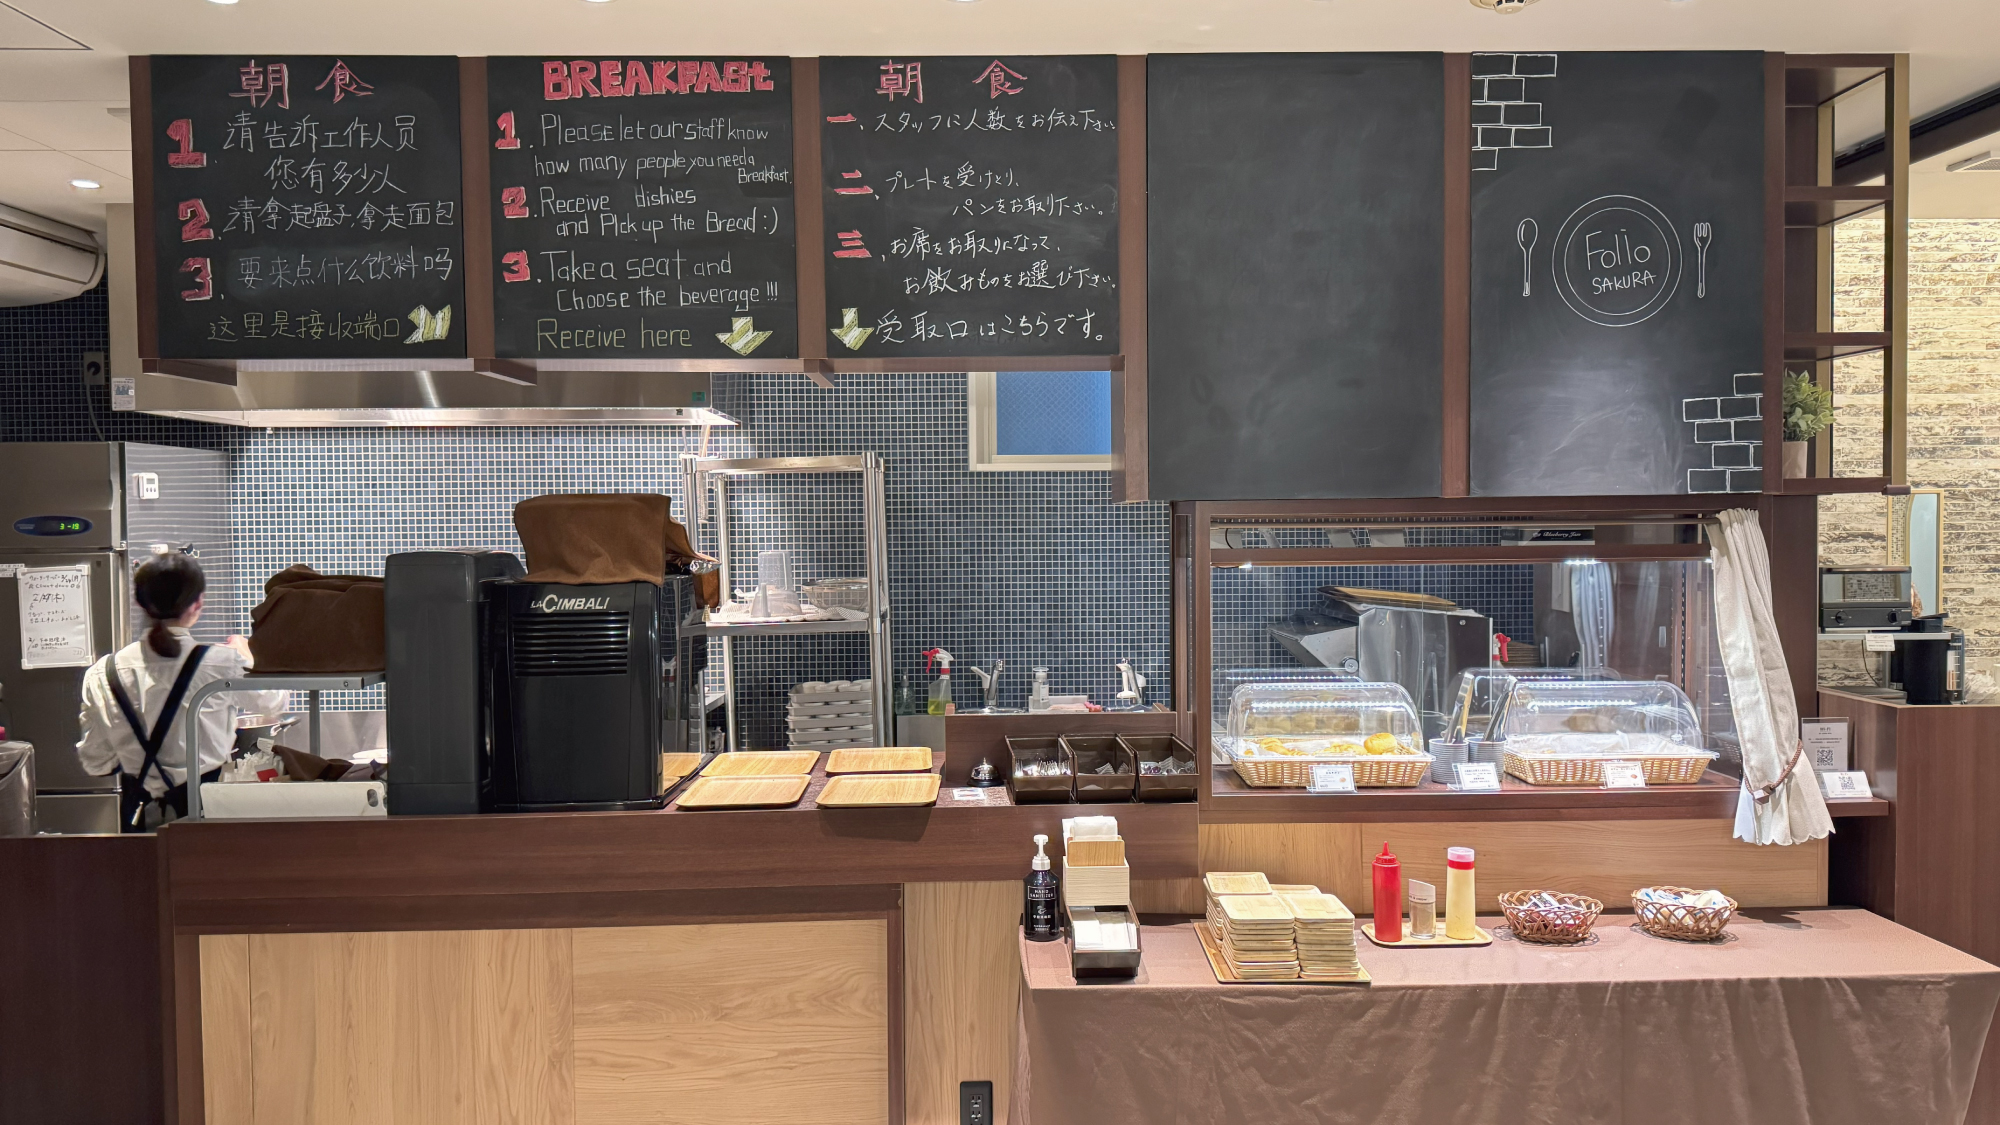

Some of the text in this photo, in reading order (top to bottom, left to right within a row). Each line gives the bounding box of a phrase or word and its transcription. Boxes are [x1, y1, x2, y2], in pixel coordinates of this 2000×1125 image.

[222, 110, 418, 152] 请告诉工作人员
[619, 114, 644, 140] let
[649, 124, 683, 140] our
[727, 125, 768, 140] know
[264, 155, 407, 195] 您有多少人
[535, 147, 754, 179] how many people you need a
[539, 186, 610, 217] Receive
[556, 213, 588, 237] and
[642, 219, 664, 243] up
[671, 213, 695, 231] the
[706, 207, 756, 233] Bread
[238, 246, 453, 289] 要来点什么饮料吗
[600, 262, 617, 280] a
[626, 249, 687, 280] seat
[693, 251, 732, 277] and
[557, 289, 631, 312] Choose
[637, 285, 666, 306] the
[680, 284, 759, 312] beverage
[1592, 270, 1657, 295] SAKURA
[207, 310, 400, 342] 这里是接收端口
[537, 317, 692, 351] Receive here
[530, 600, 543, 608] LA
